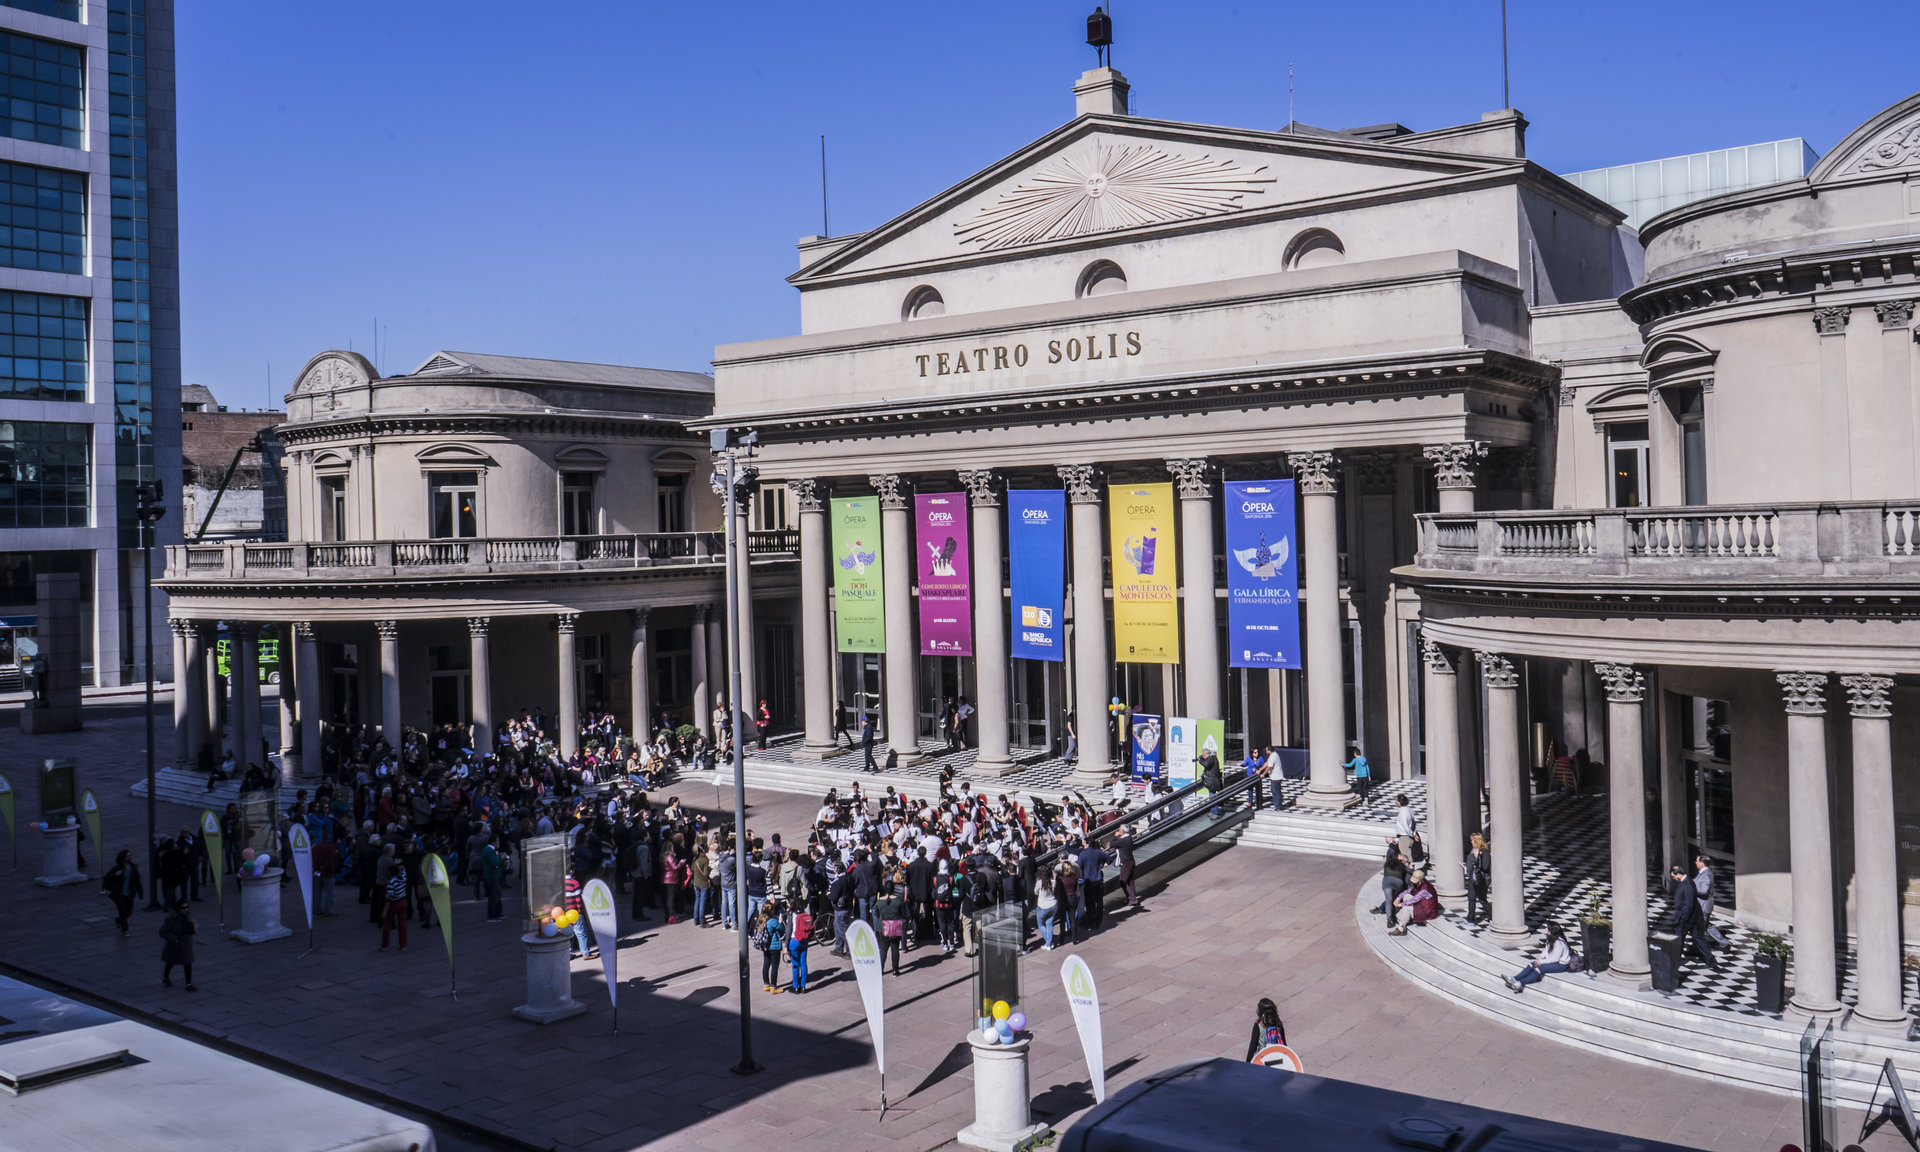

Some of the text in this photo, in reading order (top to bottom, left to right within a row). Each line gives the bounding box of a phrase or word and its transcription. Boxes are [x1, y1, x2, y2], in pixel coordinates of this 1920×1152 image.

[916, 331, 1142, 377] TEATRO SOLIS
[1127, 504, 1156, 515] ÓPERA
[1242, 501, 1274, 513] ÓPERA
[929, 511, 953, 521] ÓPERA
[1022, 508, 1049, 519] ÓPERA
[850, 582, 868, 590] DON
[1119, 584, 1168, 592] CAPULETOS
[842, 589, 876, 599] PASQUALE
[921, 589, 966, 597] SHAKESPEARE
[1119, 592, 1173, 600] MONTESCOS
[1233, 587, 1291, 597] GALA LÍRICA
[1234, 597, 1270, 605] FERNANDO
